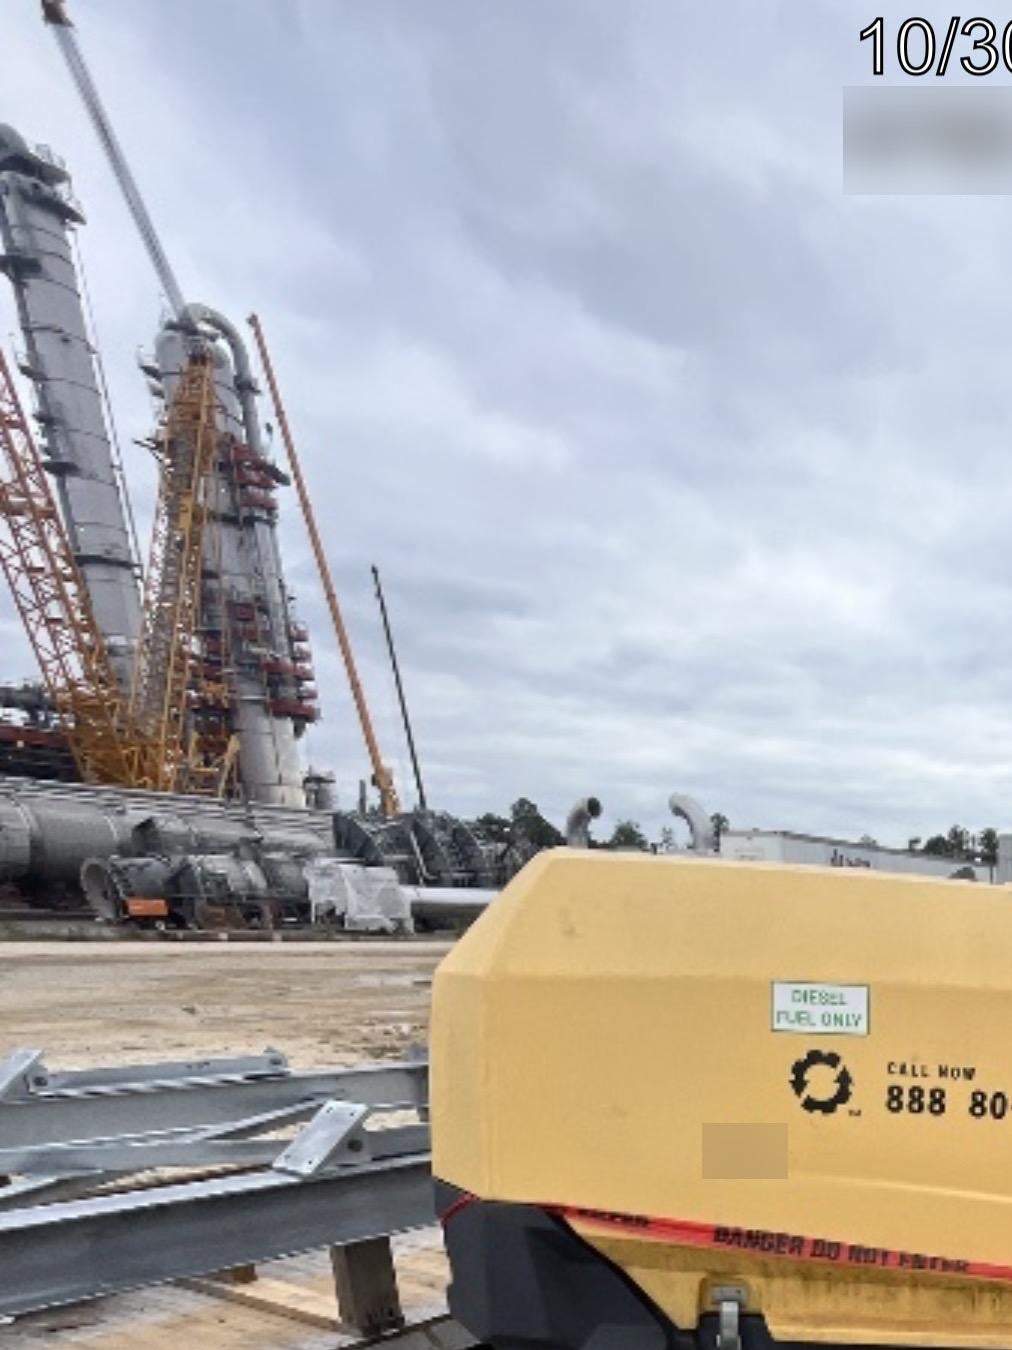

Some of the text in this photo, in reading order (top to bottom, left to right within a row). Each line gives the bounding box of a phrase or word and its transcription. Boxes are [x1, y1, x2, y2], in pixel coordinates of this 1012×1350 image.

[791, 989, 847, 1006] DIESEL
[776, 1010, 862, 1028] FUEL ONLY
[886, 1061, 976, 1081] CALL NOW
[886, 1085, 947, 1116] 888
[713, 1226, 805, 1256] DANGER
[810, 1238, 842, 1261] DO
[848, 1244, 889, 1267] NOT
